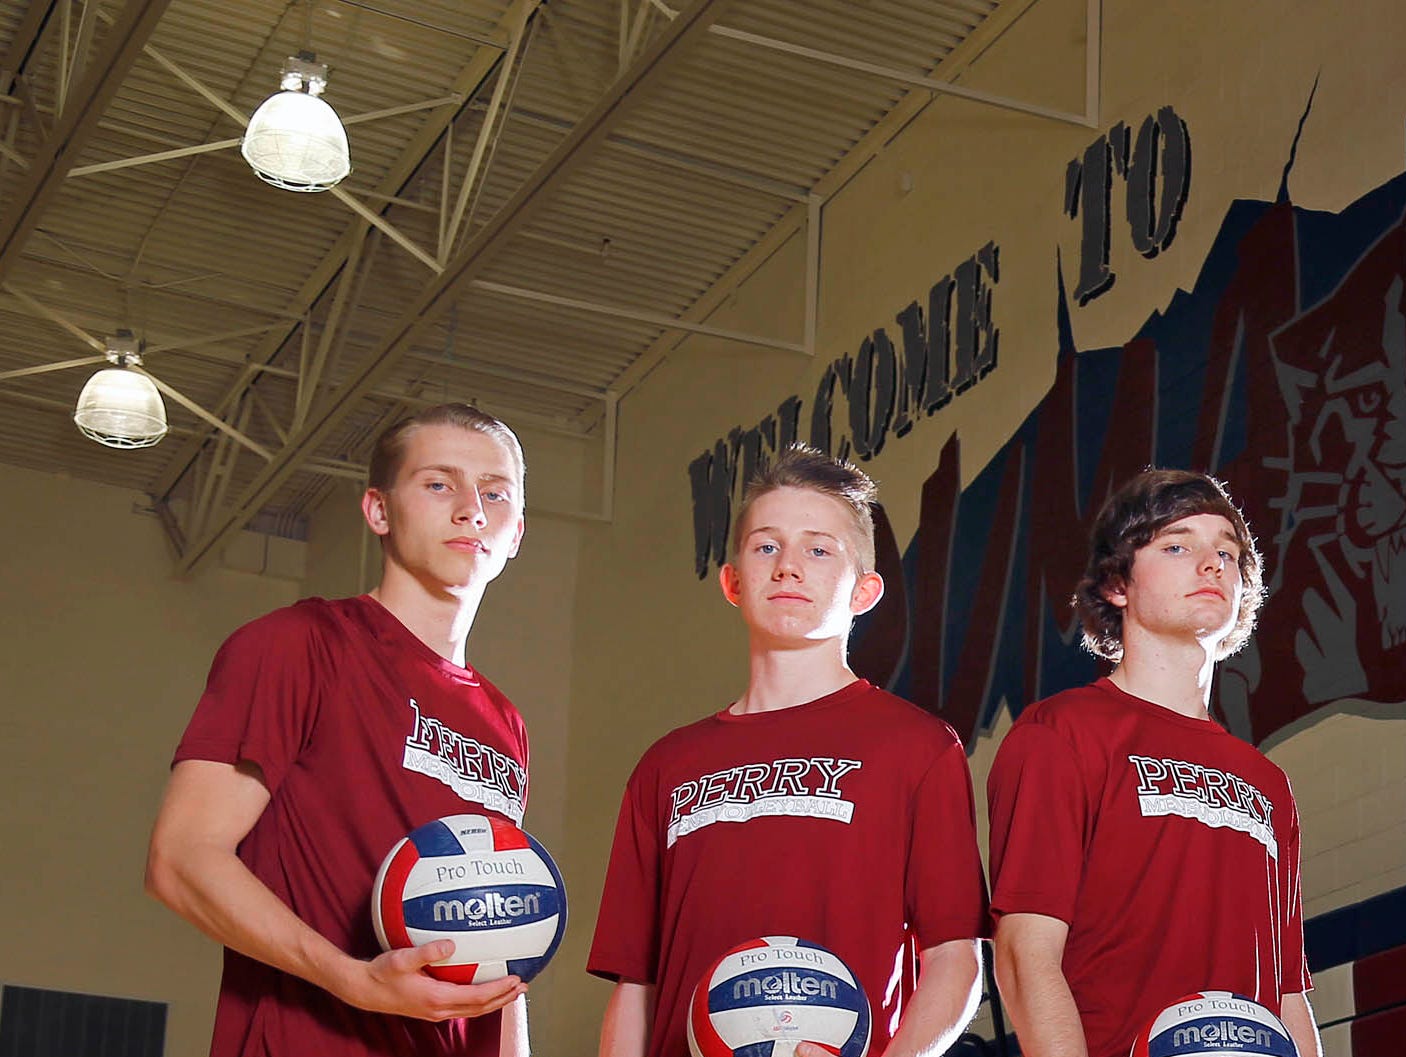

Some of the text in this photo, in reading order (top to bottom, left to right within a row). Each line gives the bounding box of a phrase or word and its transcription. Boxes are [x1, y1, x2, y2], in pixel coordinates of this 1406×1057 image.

[1064, 104, 1191, 308] TO
[668, 757, 862, 824] PERRY
[1128, 755, 1275, 834] PERRY
[436, 858, 525, 882] Pro Touch
[433, 892, 541, 922] molten
[740, 949, 824, 967] Pro Touch
[733, 971, 838, 1000] molten
[1177, 1000, 1256, 1017] Pro Touch
[1173, 1021, 1272, 1048] molten
